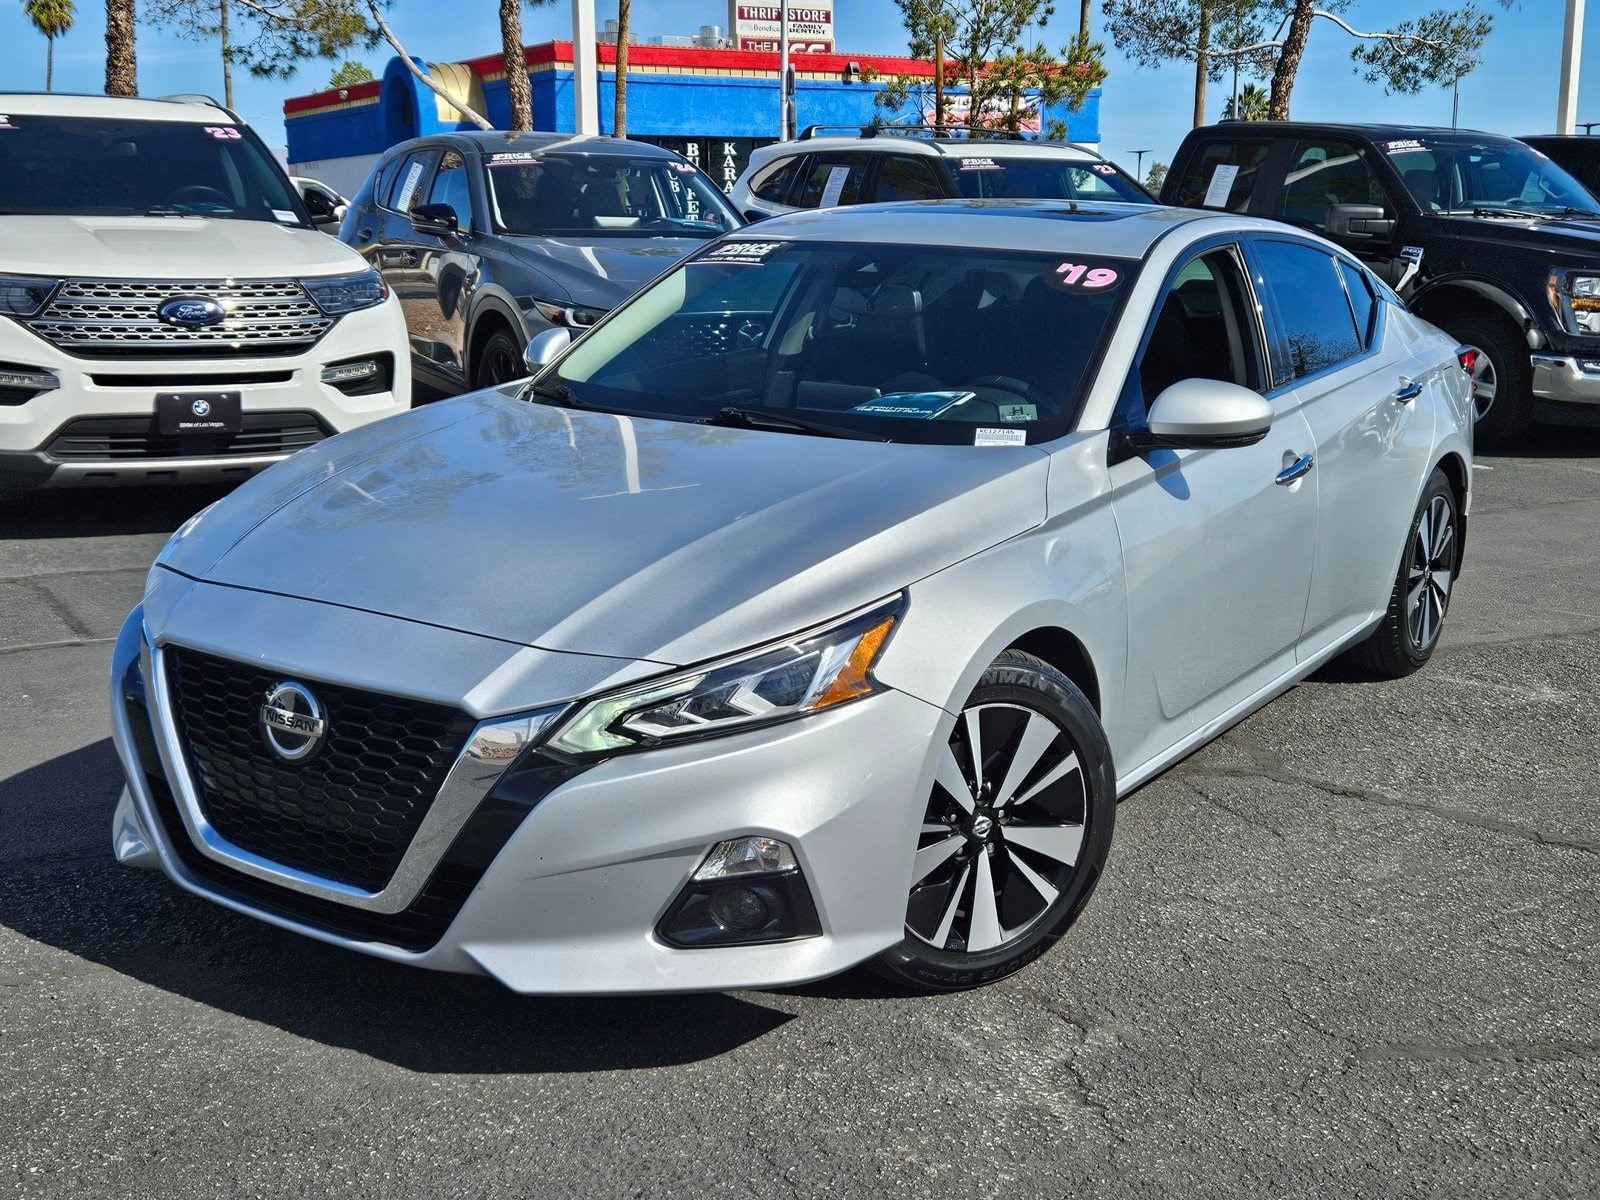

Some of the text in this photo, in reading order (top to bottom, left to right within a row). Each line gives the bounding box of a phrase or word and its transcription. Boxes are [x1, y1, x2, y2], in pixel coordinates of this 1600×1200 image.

[789, 9, 826, 21] STORE
[746, 41, 772, 52] THE
[723, 142, 737, 195] KARA
[1055, 262, 1118, 288] '19
[981, 669, 1048, 691] NMAN
[266, 710, 315, 732] NISSAN
